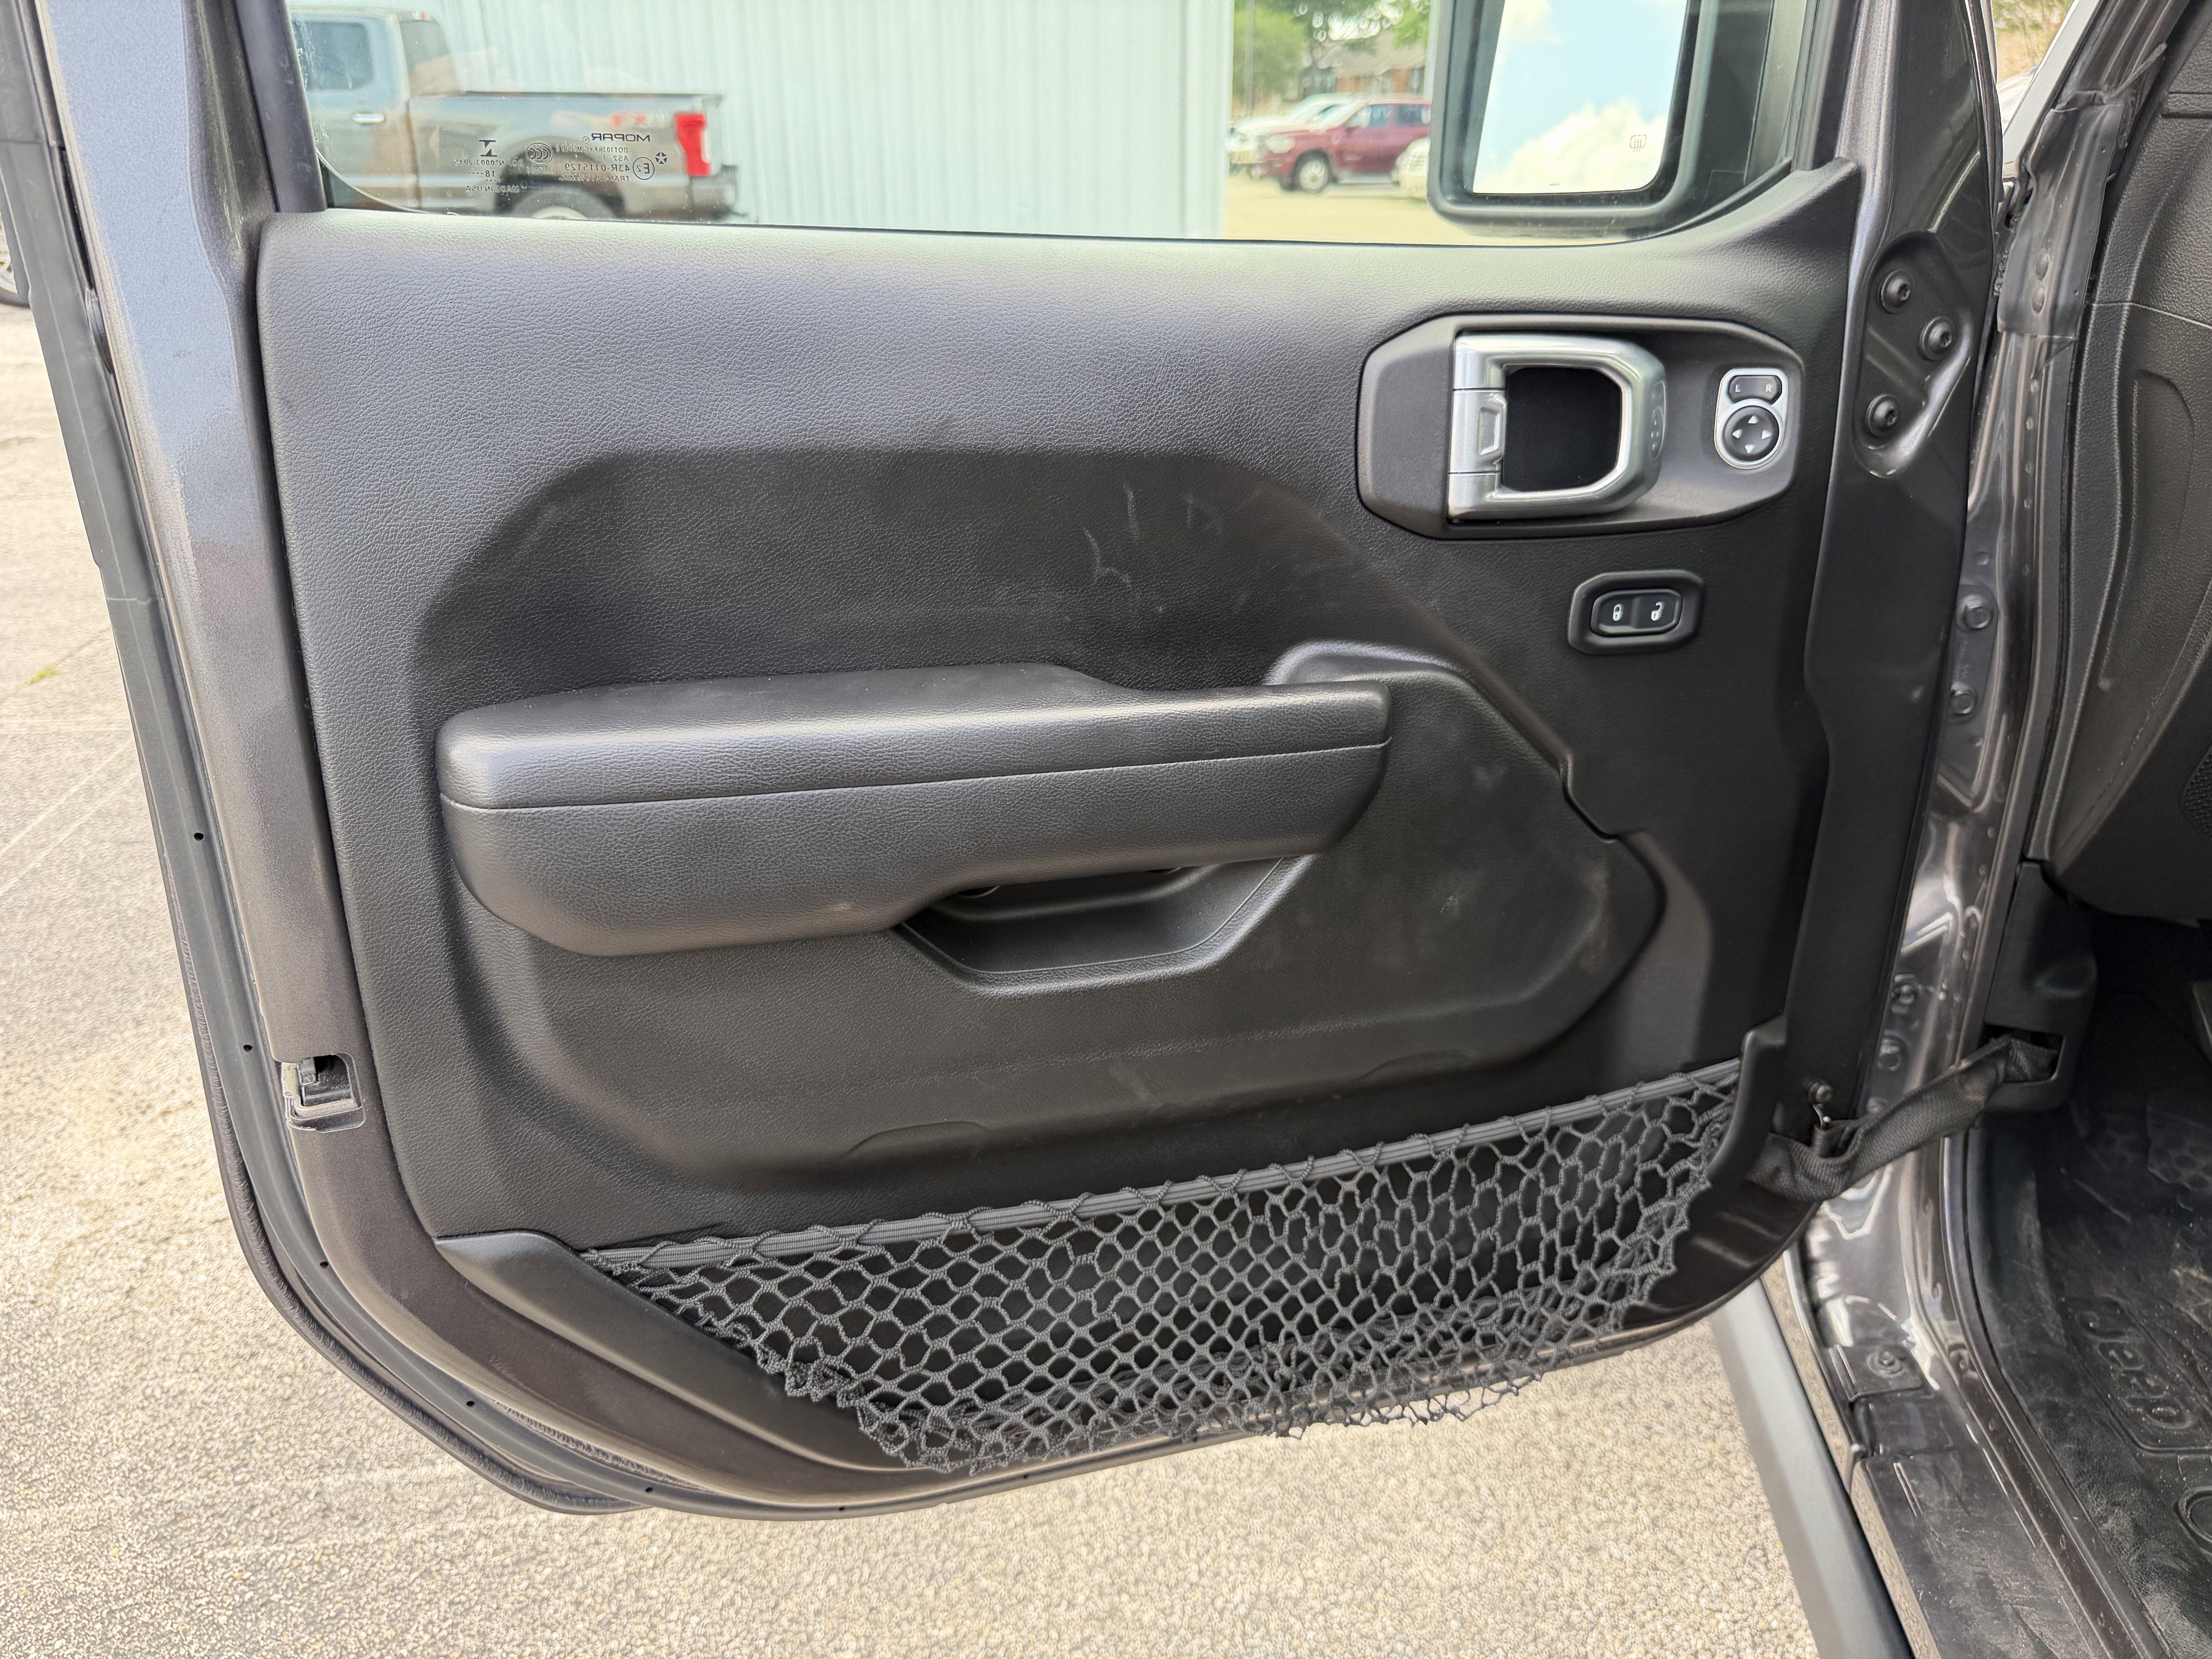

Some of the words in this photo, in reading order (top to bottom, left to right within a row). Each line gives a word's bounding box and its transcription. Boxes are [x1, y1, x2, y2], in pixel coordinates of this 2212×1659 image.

[1735, 384, 1741, 392] L
[1765, 383, 1772, 392] R
[2074, 1310, 2193, 1429] Jeep
